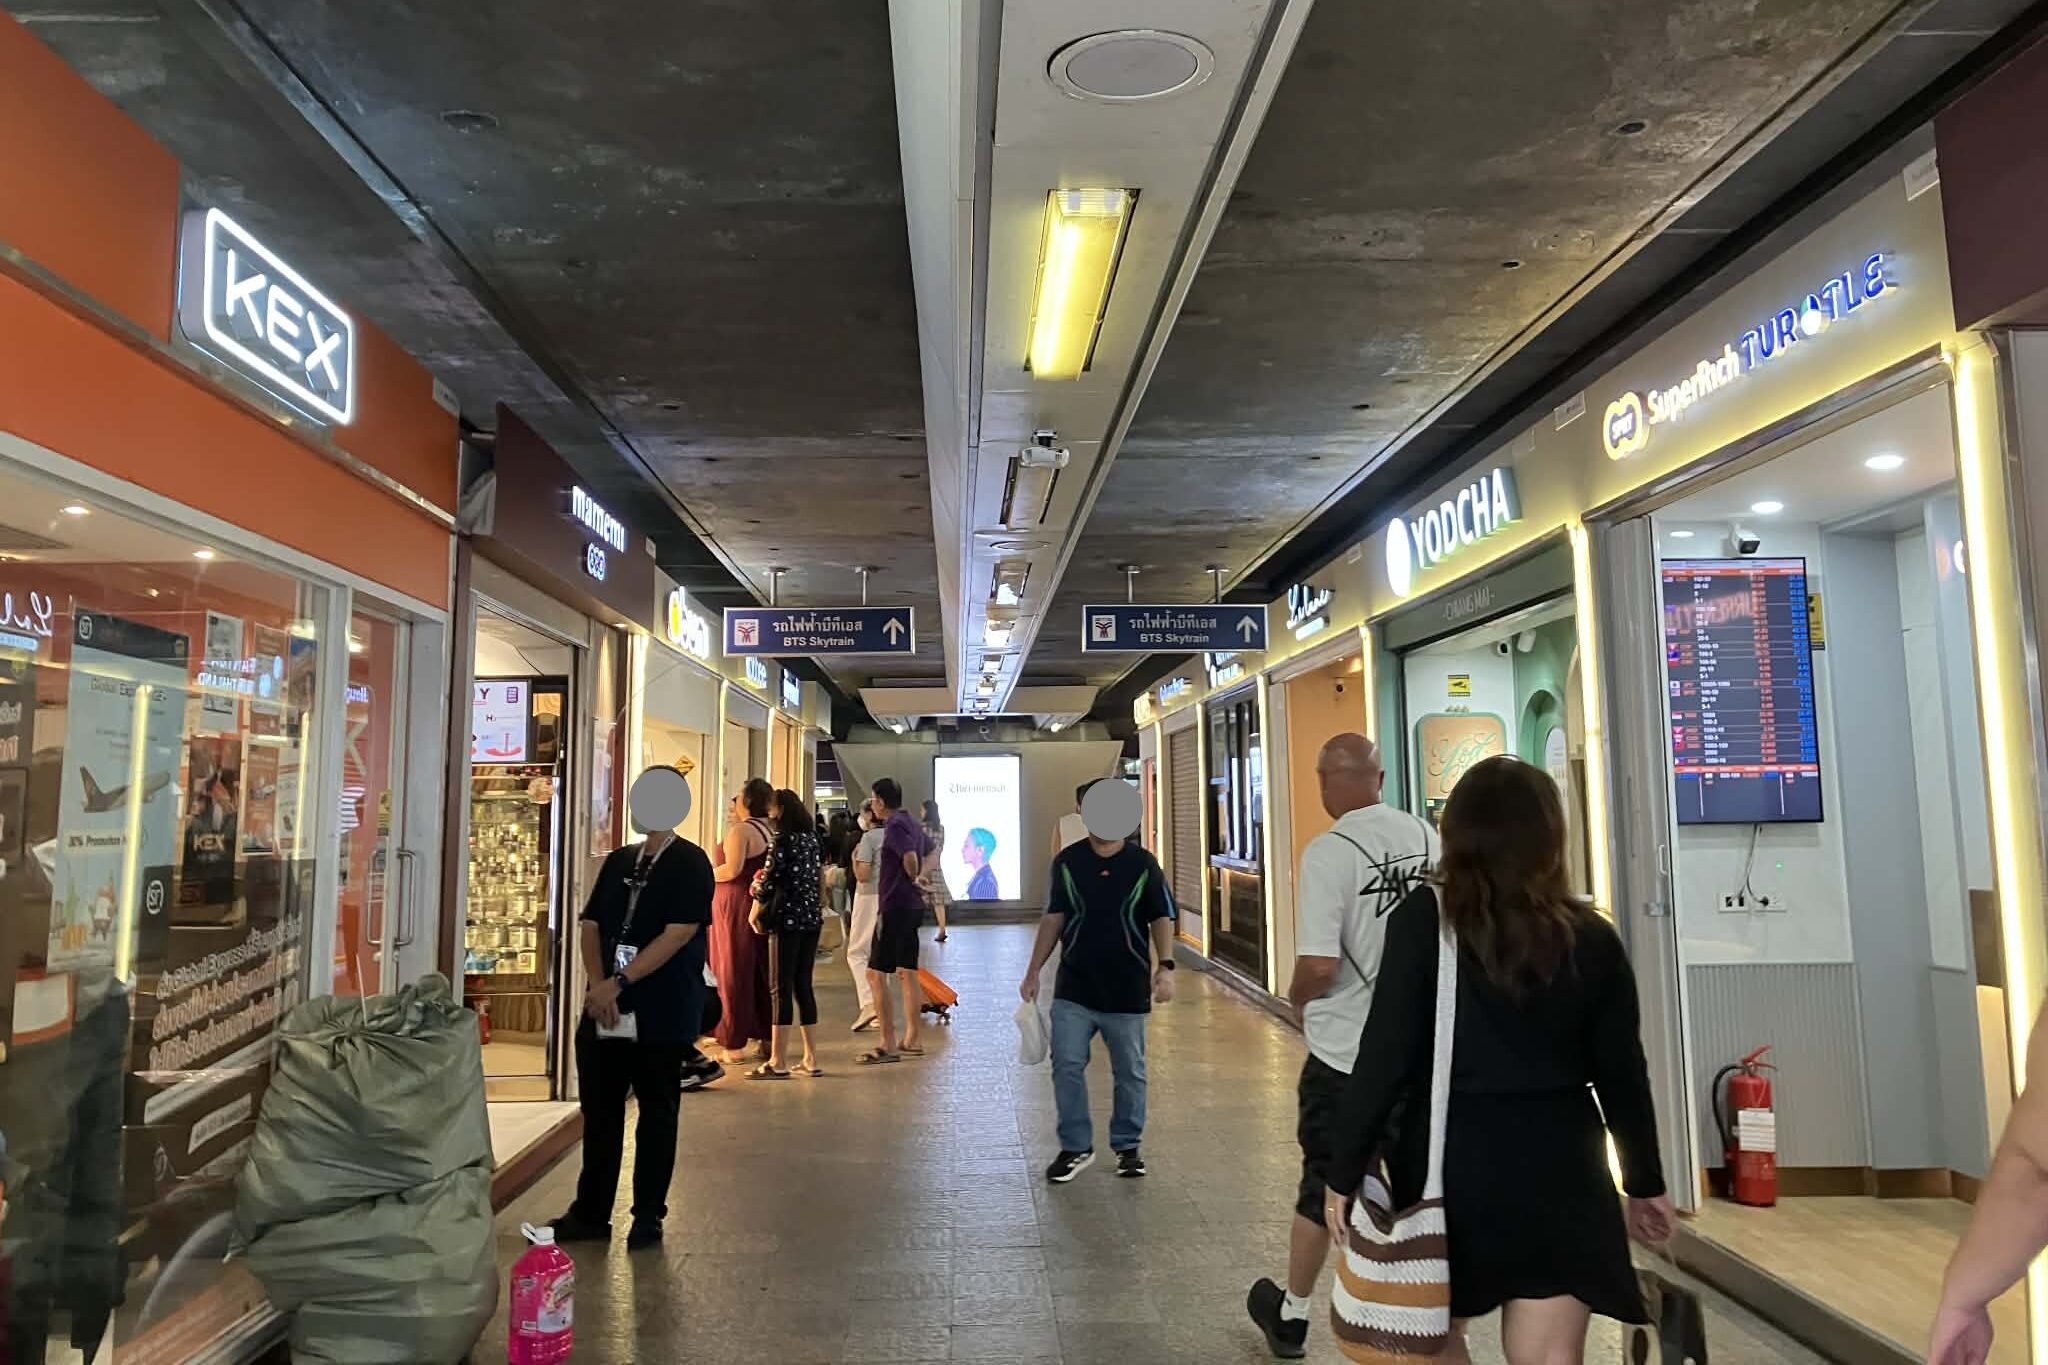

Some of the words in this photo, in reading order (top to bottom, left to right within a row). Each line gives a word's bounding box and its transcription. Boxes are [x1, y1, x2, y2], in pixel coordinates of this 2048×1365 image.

[226, 249, 340, 390] KEX
[1648, 343, 1740, 424] SuperRich
[1411, 468, 1511, 570] YODCHA
[772, 612, 864, 633] รถไฟฟ้าบีทีเอส
[1129, 609, 1217, 629] รถไฟฟ้าบีทีเอส
[783, 636, 807, 647] BTS
[809, 635, 855, 648] Skytrain
[1140, 633, 1163, 643] BTS
[1165, 633, 1209, 645] Skytrain
